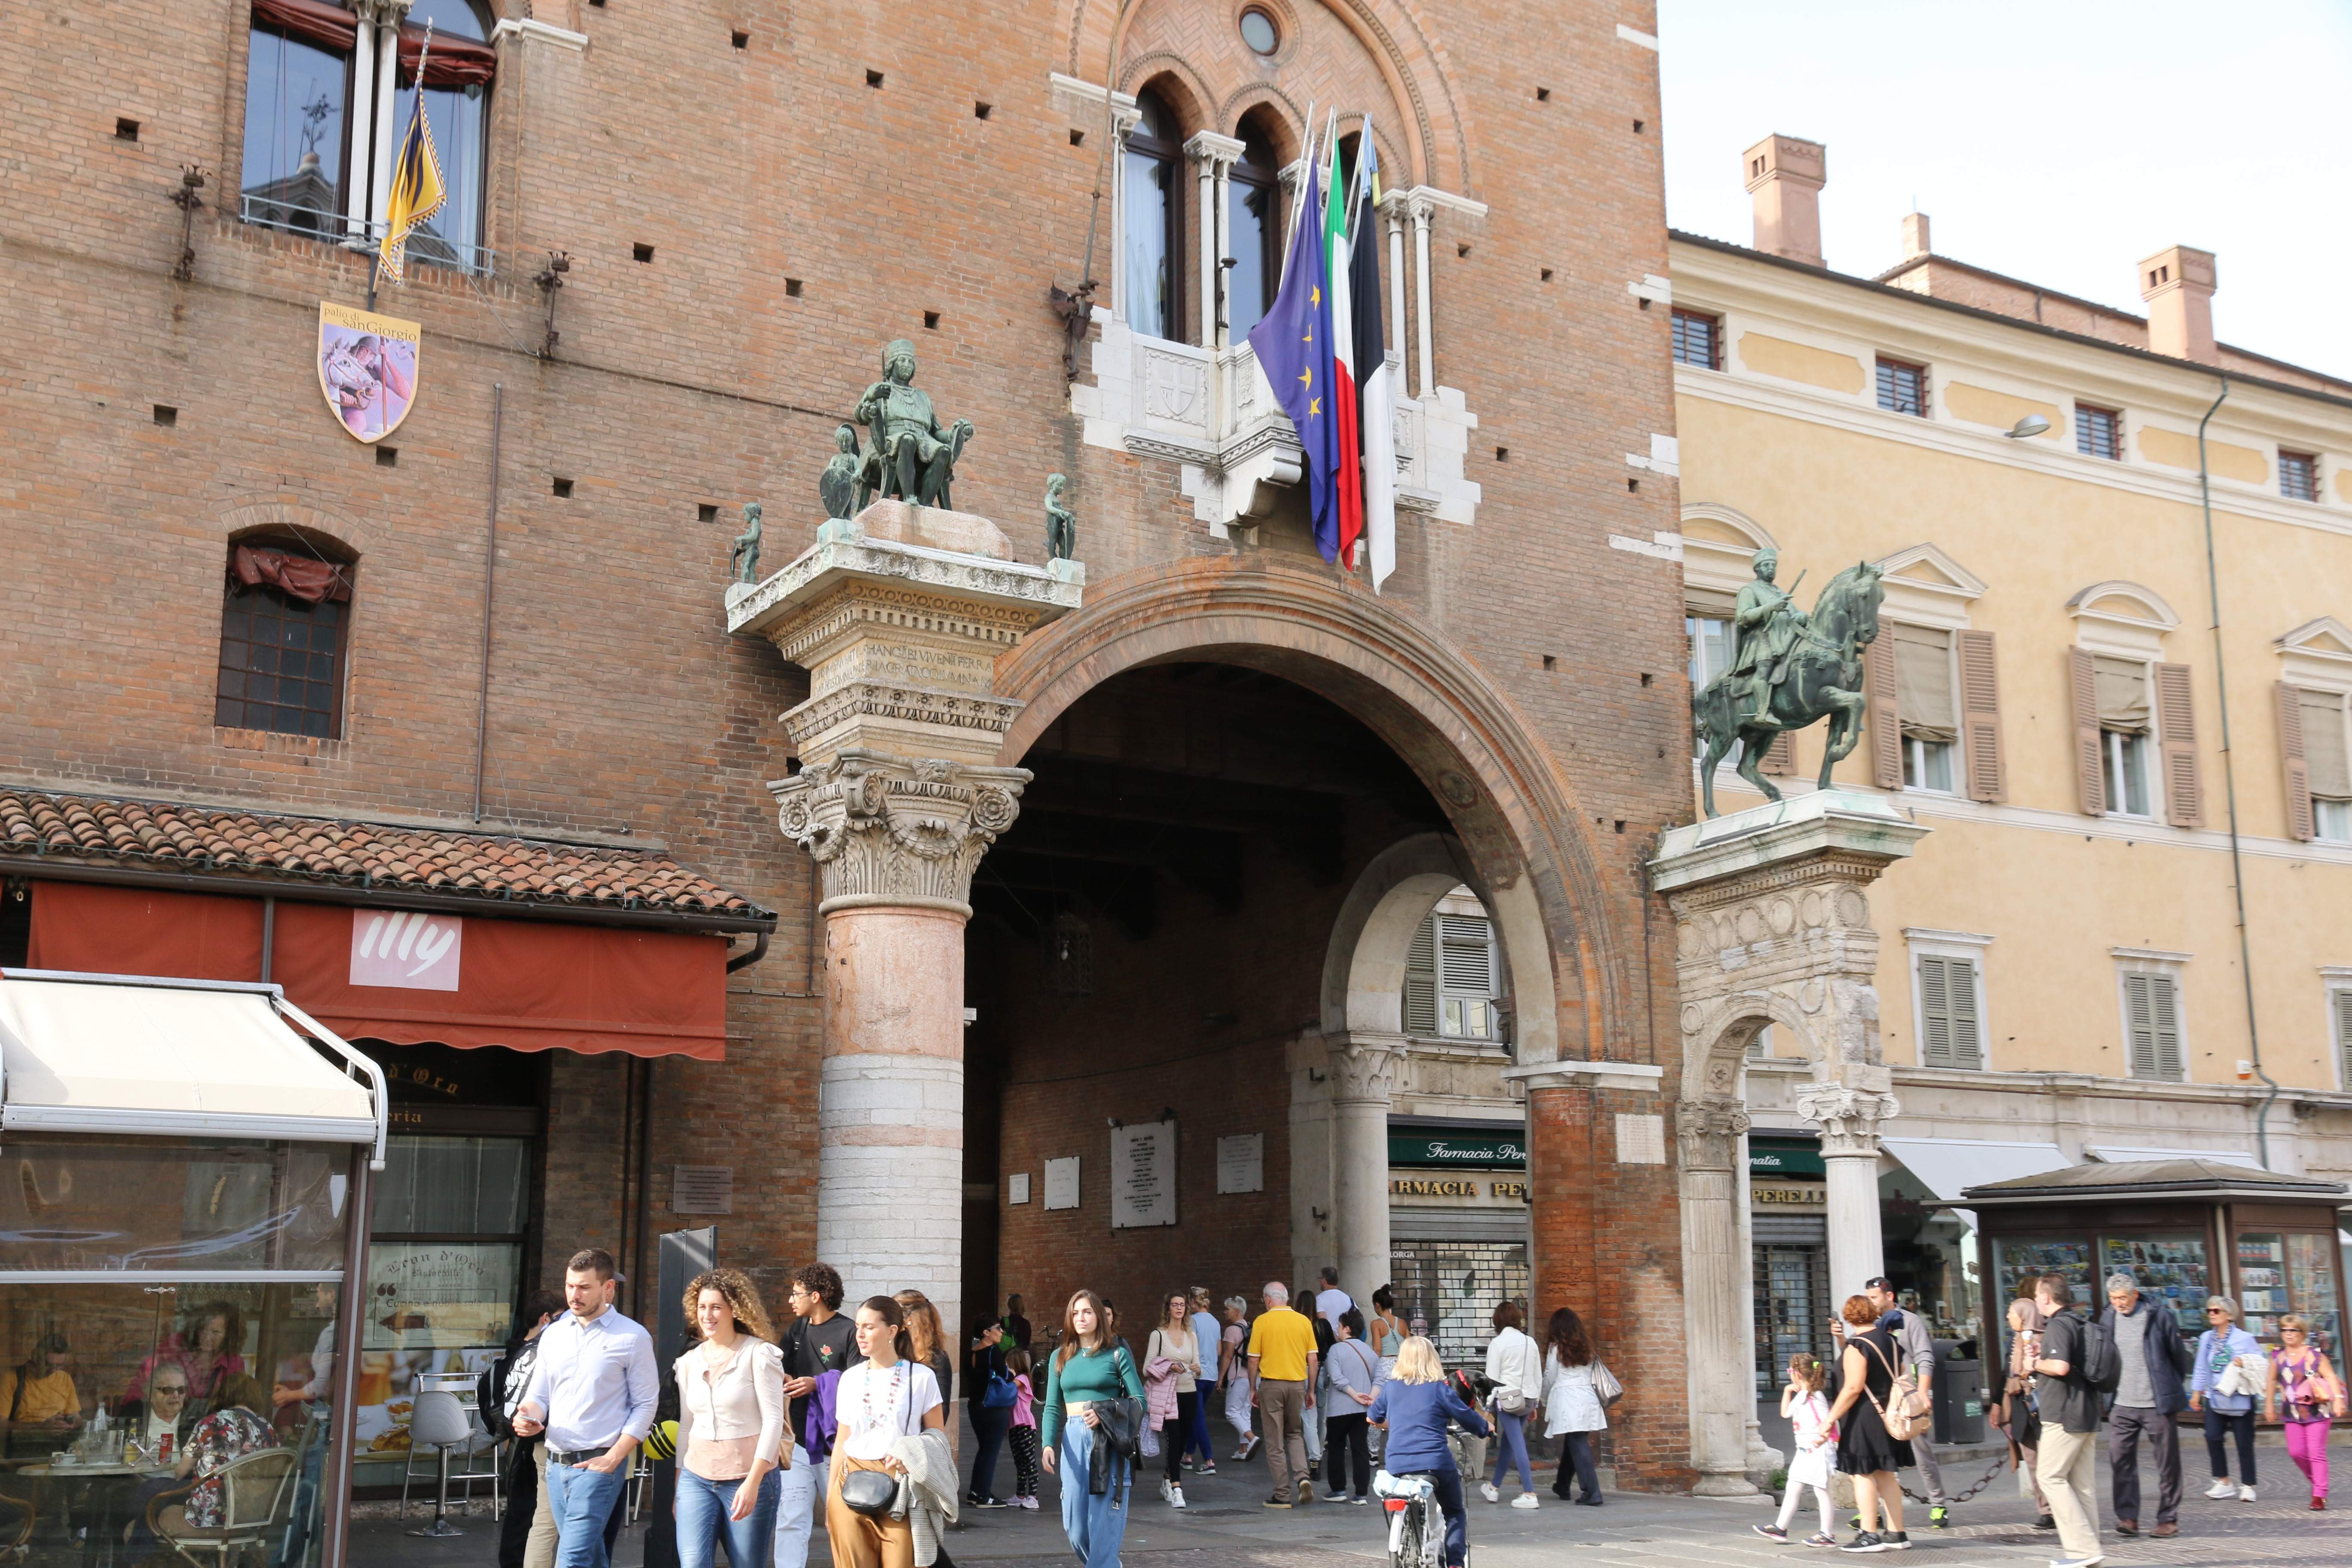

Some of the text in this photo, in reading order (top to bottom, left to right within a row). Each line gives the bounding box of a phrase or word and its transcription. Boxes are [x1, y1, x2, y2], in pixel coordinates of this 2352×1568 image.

[325, 307, 359, 321] palio di
[343, 319, 416, 342] sanGiorgio
[359, 911, 456, 977] illy
[1427, 1142, 1494, 1159] Farmacia
[1494, 1182, 1527, 1196] PE
[412, 1268, 461, 1277] Ristorante
[386, 1298, 420, 1308] Cucina
[463, 1298, 482, 1307] sale
